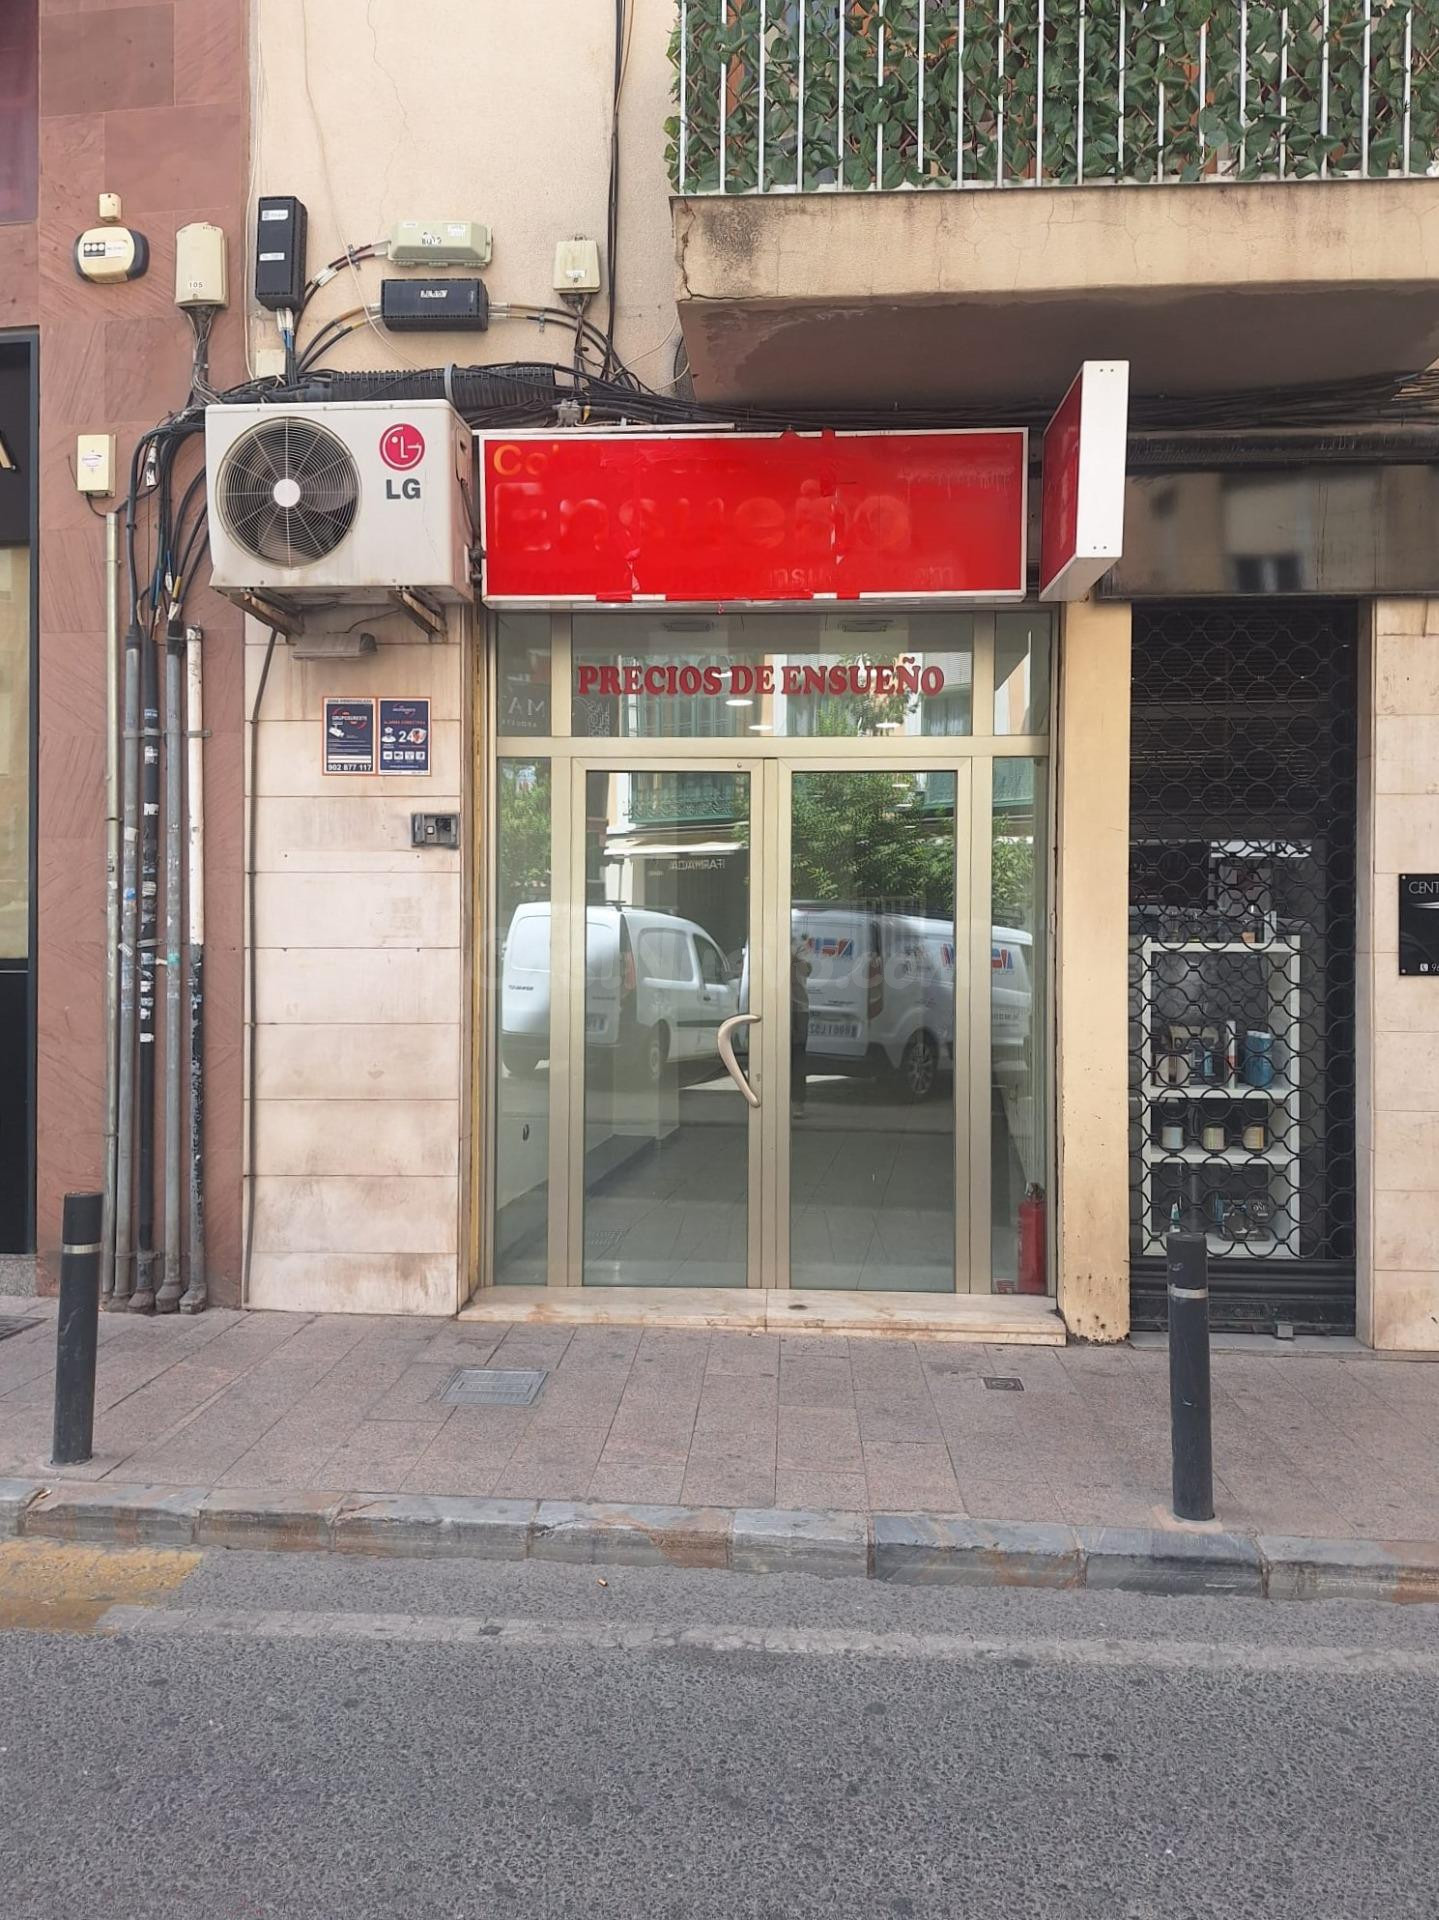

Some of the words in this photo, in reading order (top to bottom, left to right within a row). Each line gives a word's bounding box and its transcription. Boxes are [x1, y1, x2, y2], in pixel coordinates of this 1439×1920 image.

[188, 281, 204, 289] 105
[385, 478, 421, 501] LG
[577, 664, 724, 697] PRECIOS
[730, 664, 775, 696] DE
[781, 657, 945, 697] ENSUEÑO
